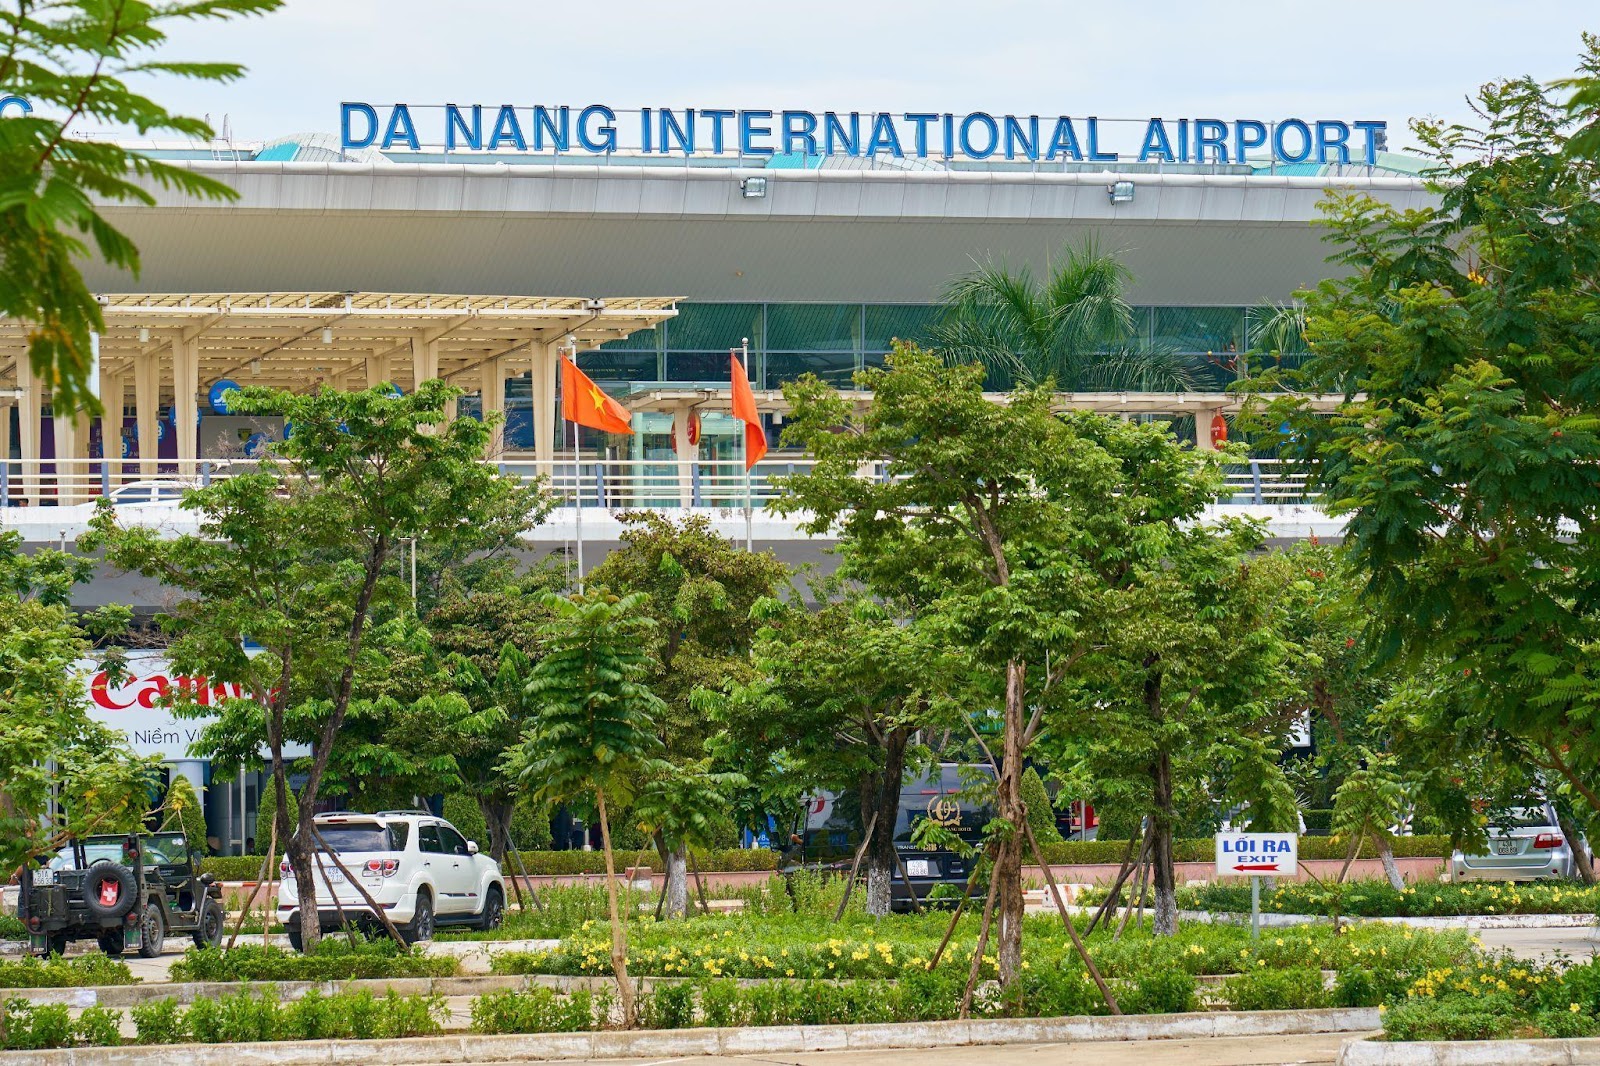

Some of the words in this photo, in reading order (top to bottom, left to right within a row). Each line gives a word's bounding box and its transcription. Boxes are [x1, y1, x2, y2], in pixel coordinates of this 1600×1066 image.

[341, 102, 421, 151] DA
[445, 103, 617, 154] NANG
[642, 107, 1118, 162] INTERNATIONAL
[1137, 117, 1387, 165] AIRPORT
[91, 670, 282, 710] Can
[134, 727, 180, 744] Niềm
[1223, 836, 1256, 853] LỐI
[1263, 839, 1291, 853] RA
[1237, 855, 1278, 863] EXIT
